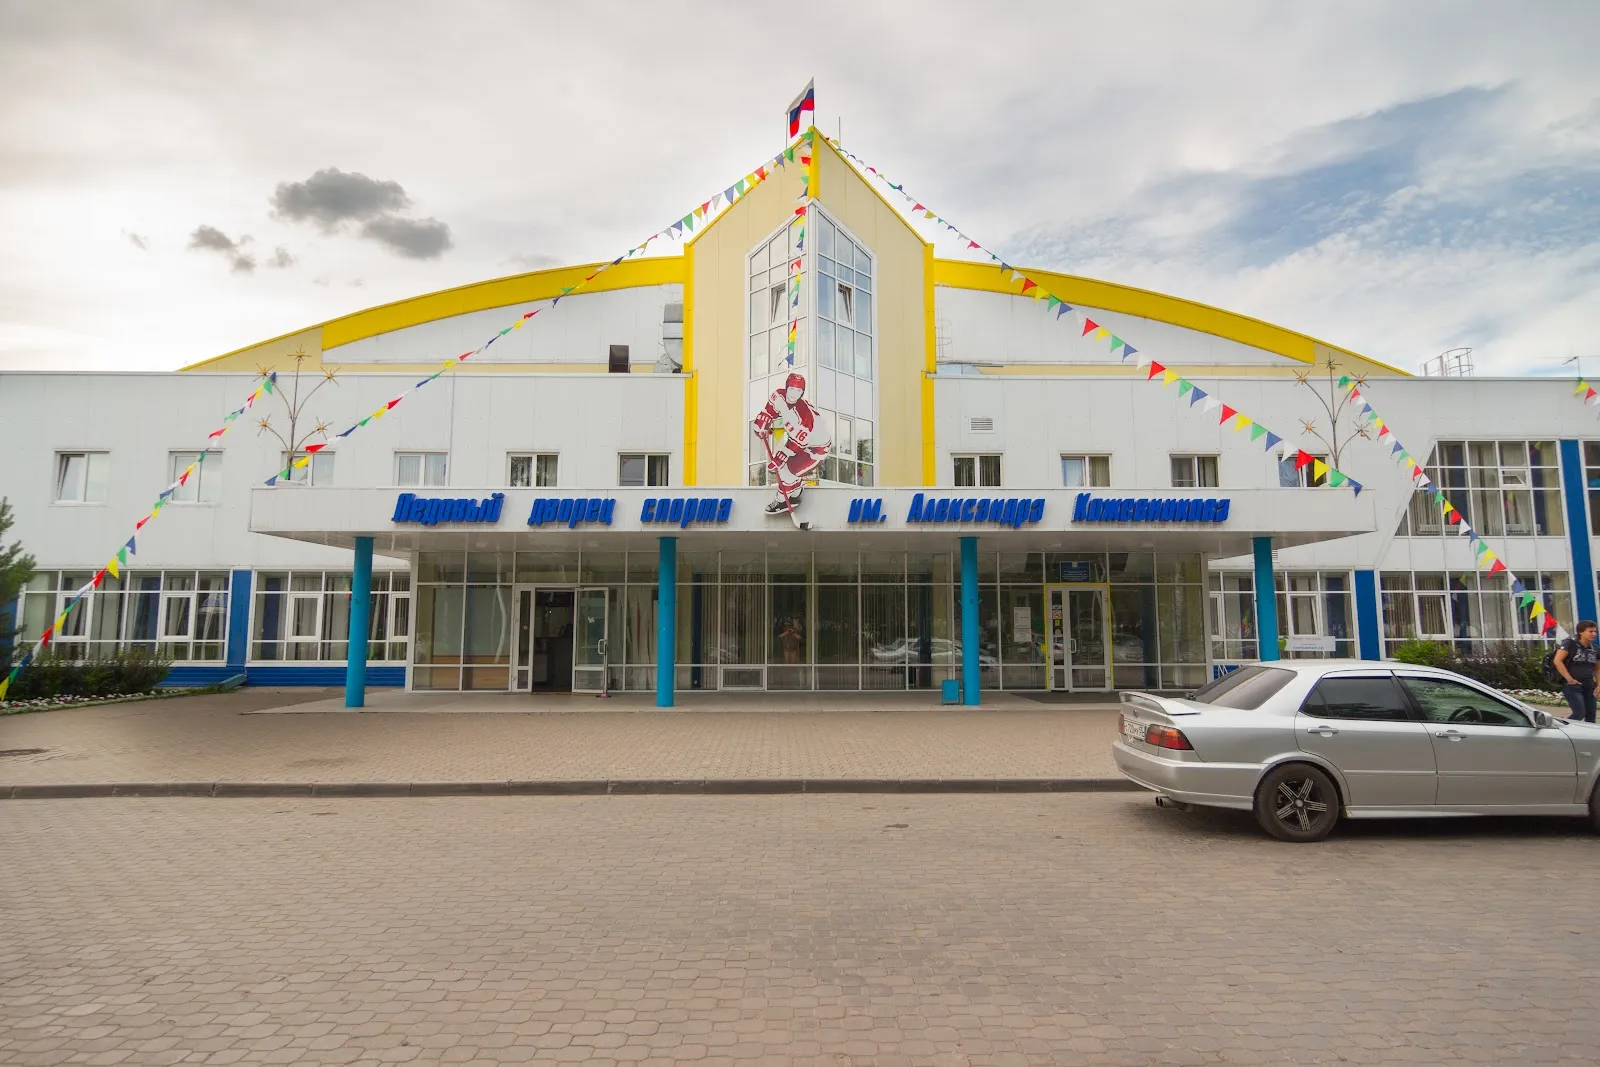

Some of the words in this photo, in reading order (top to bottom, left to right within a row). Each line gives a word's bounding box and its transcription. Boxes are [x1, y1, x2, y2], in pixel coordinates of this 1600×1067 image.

[795, 429, 807, 441] 16
[392, 493, 504, 525] Ледовый
[527, 498, 616, 528] дворец
[640, 498, 733, 528] спорта
[847, 498, 887, 522] им.
[907, 493, 1046, 528] Александра
[1072, 493, 1231, 522] Кожевникова
